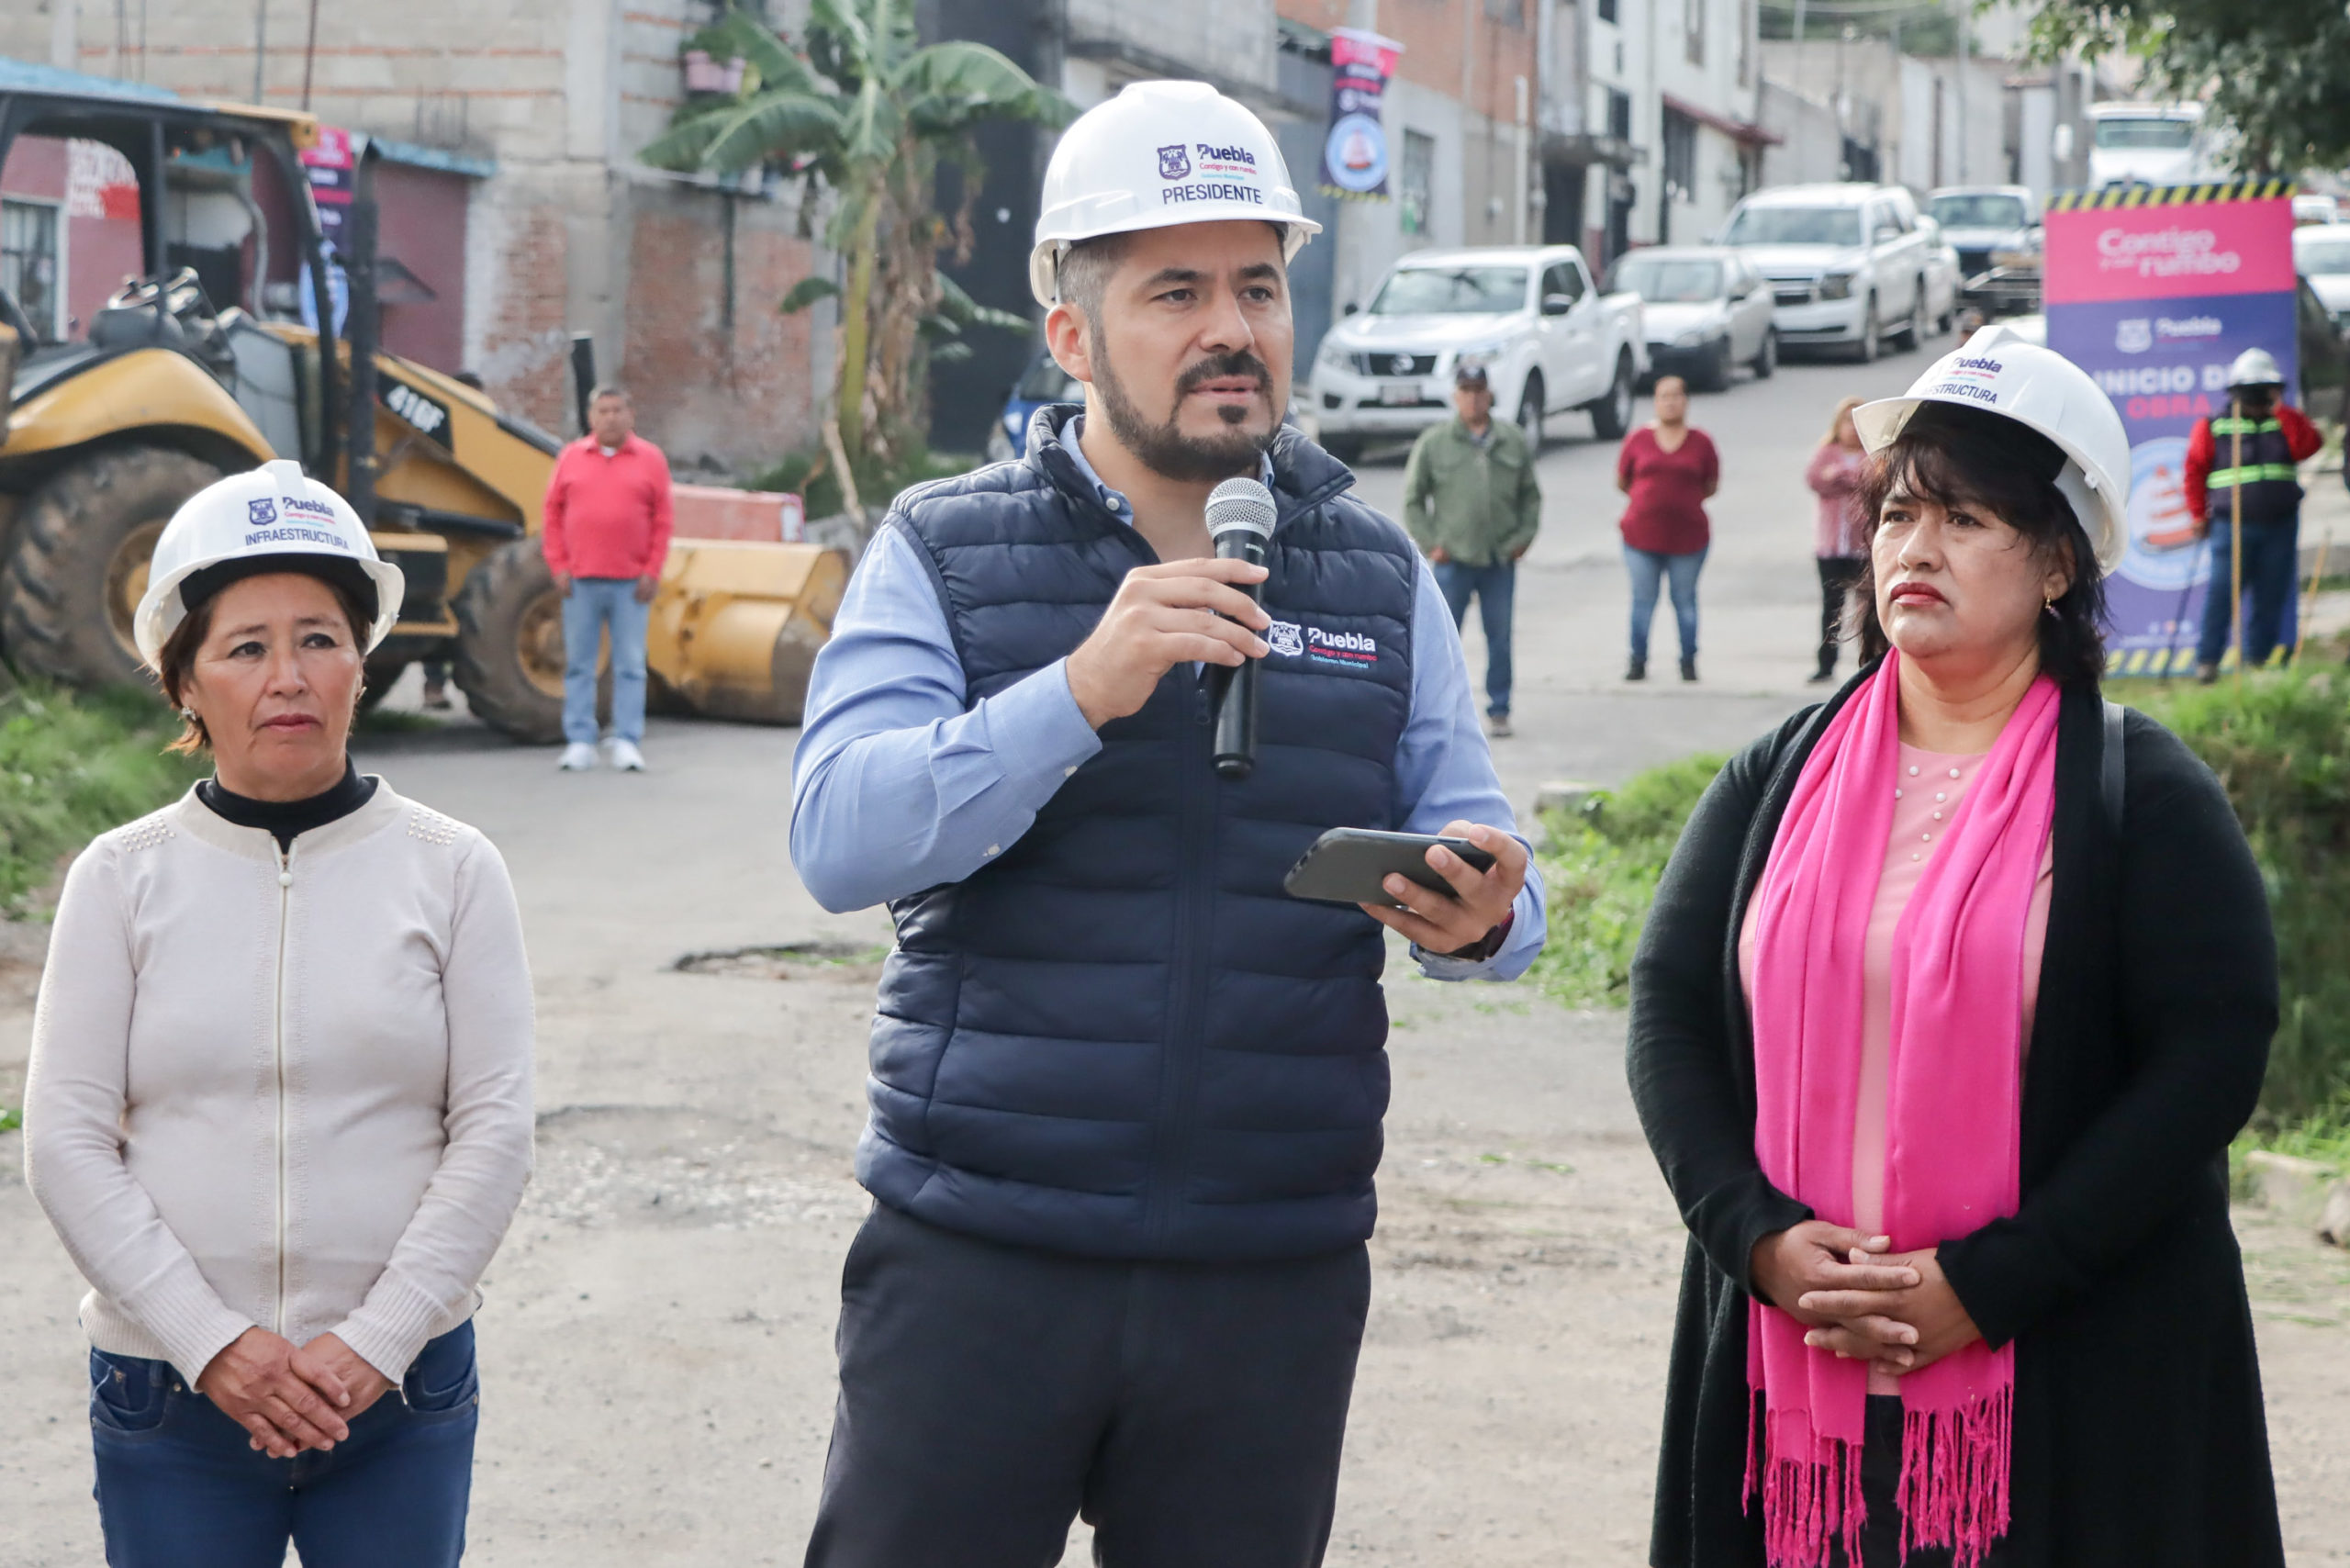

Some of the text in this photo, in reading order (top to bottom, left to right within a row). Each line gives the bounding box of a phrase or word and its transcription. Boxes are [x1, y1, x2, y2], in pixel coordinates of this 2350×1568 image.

[1196, 143, 1256, 165] Puebla
[1162, 184, 1263, 205] PRESIDENTE
[2098, 227, 2216, 258] Contigo
[2140, 251, 2241, 276] rumbo
[2155, 316, 2222, 337] Puebla
[2126, 394, 2211, 420] OBRA
[282, 497, 334, 517] Puebla
[245, 528, 351, 549] INFRAESTRUCTURA
[1308, 627, 1376, 652] Puebla
[1309, 644, 1336, 657] Contigo
